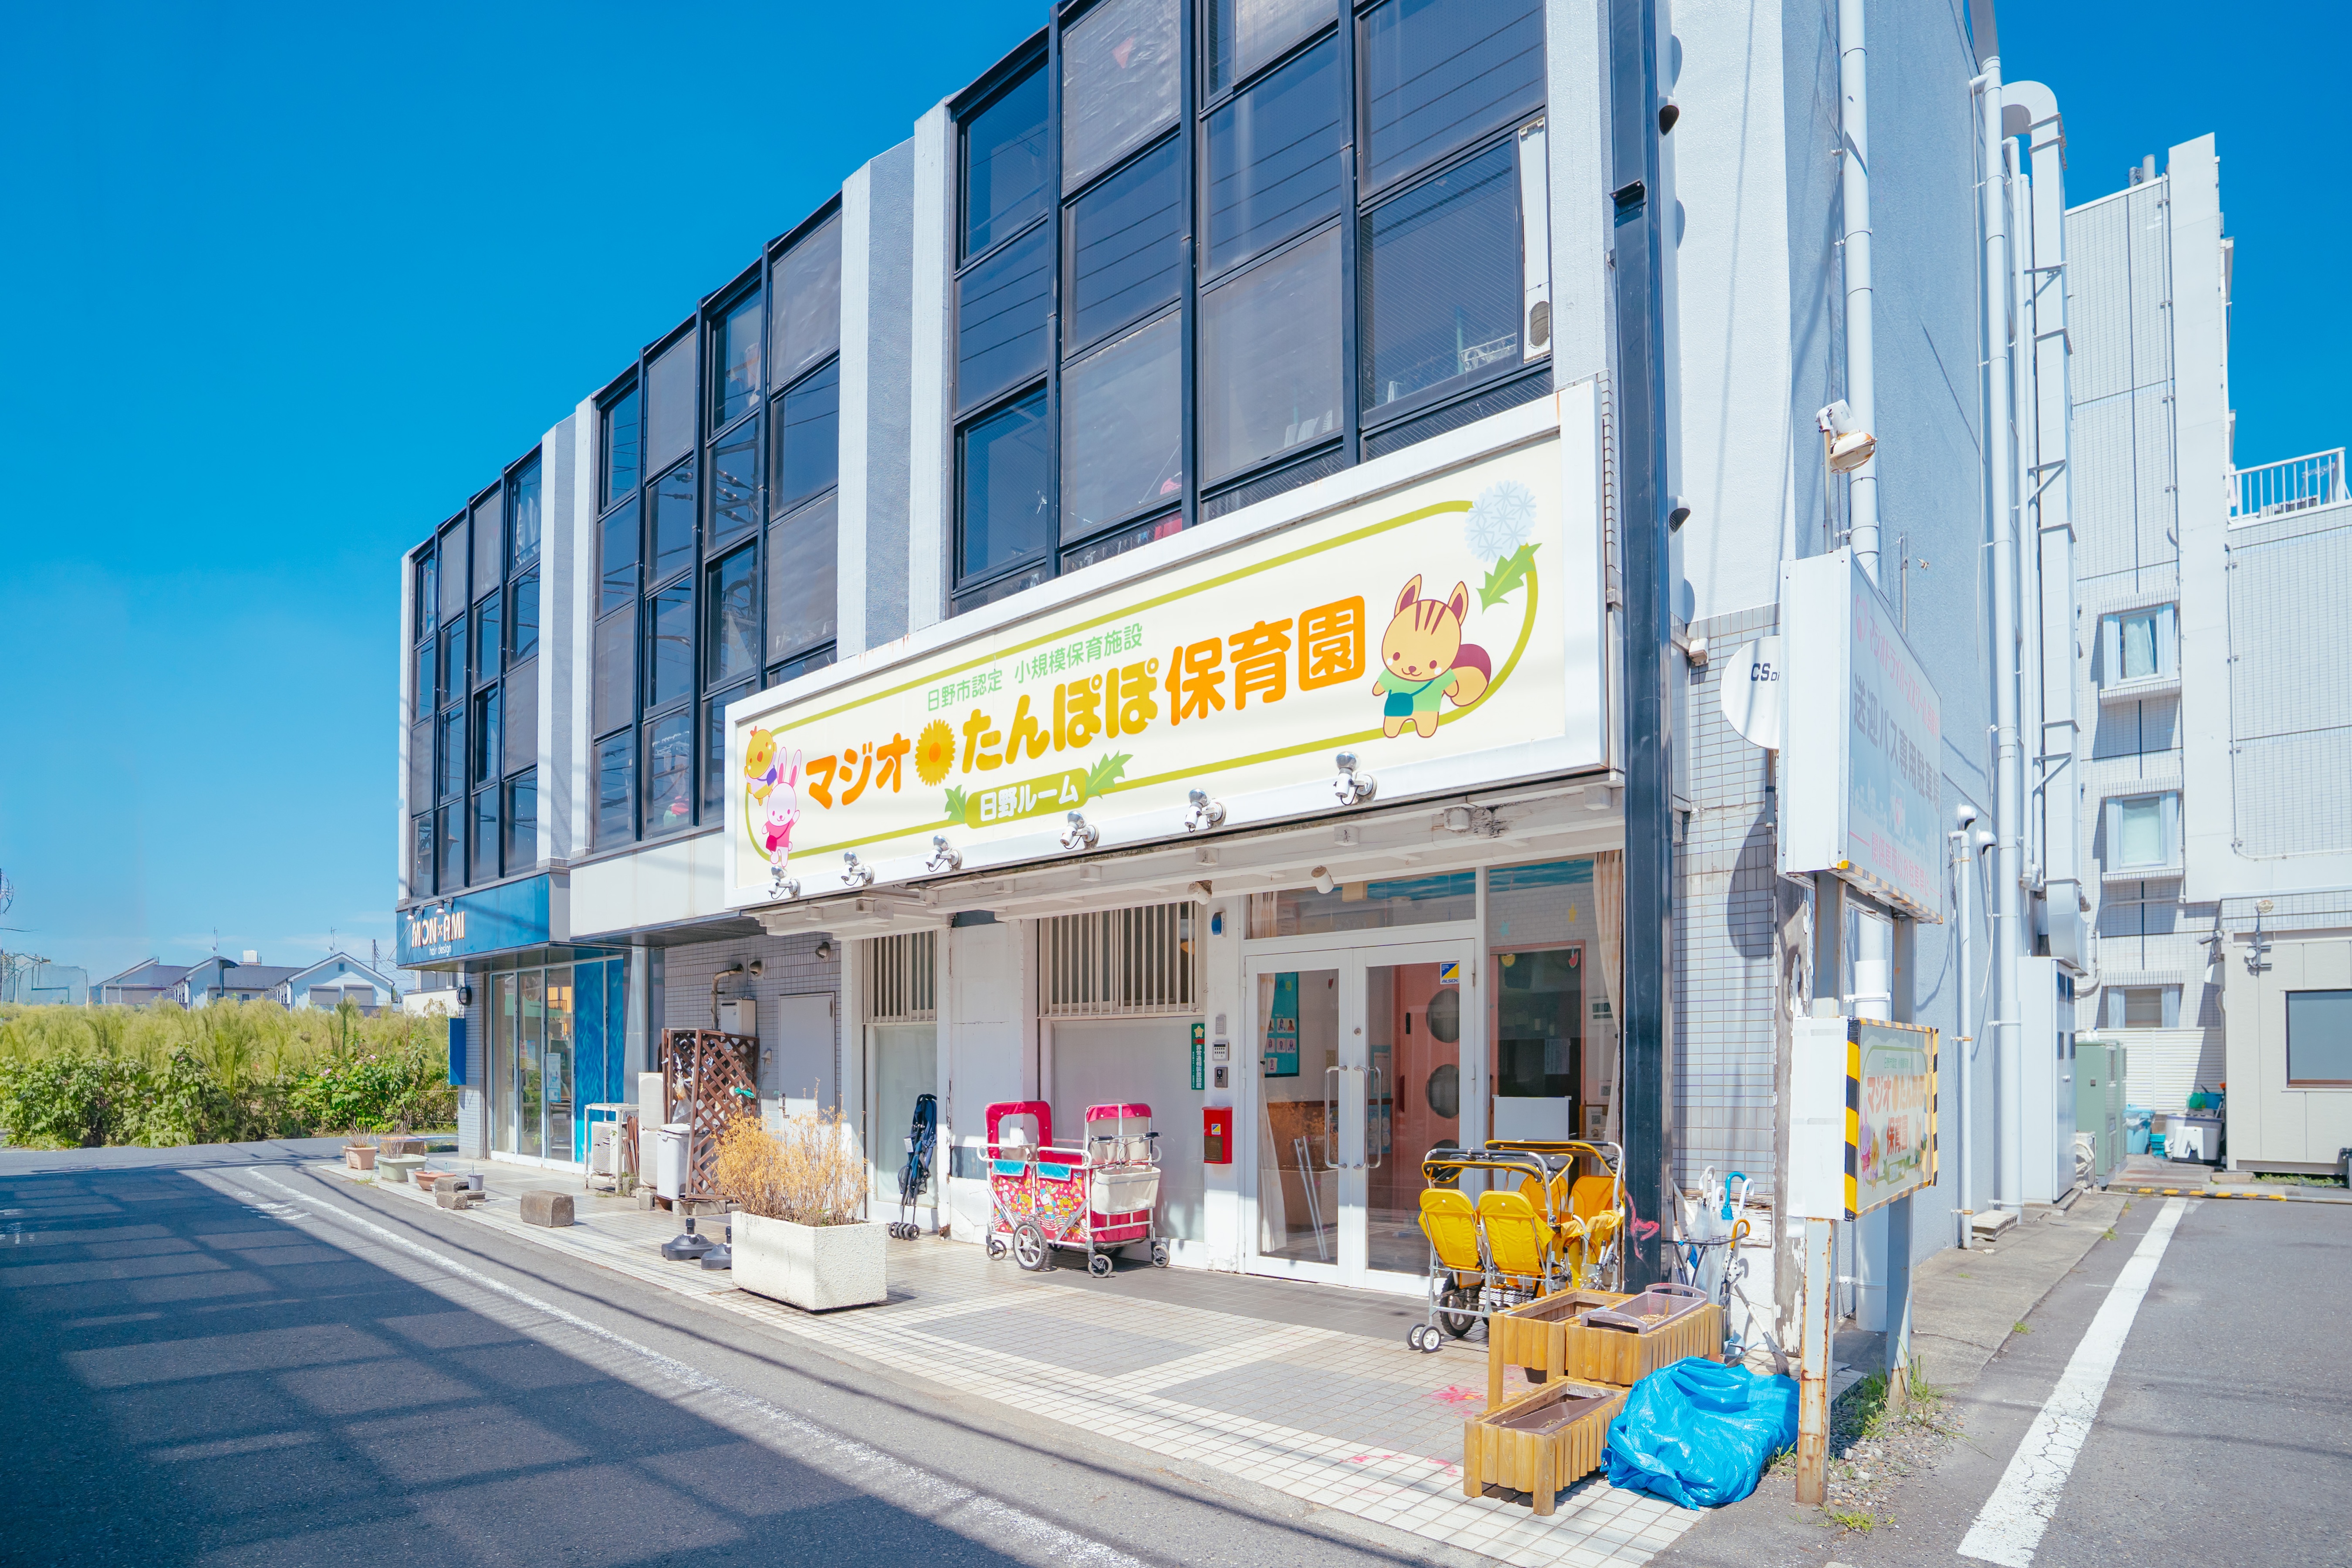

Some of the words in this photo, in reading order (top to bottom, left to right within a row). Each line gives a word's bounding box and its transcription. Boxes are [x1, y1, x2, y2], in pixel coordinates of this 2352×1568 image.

[928, 669, 1003, 712] 日野市認定
[1014, 622, 1143, 684] 小規模保育施設
[1751, 663, 1771, 681] CS
[806, 733, 911, 810] マジオ
[962, 595, 1366, 774] たんぽぽ保育園
[1854, 671, 1940, 815] 送迎バス専用駐車場
[980, 775, 1079, 822] 日野ルーム
[429, 946, 438, 956] hair
[438, 944, 452, 956] design
[1867, 1075, 1892, 1114] マジオ
[1886, 1115, 1908, 1156] 保育園
